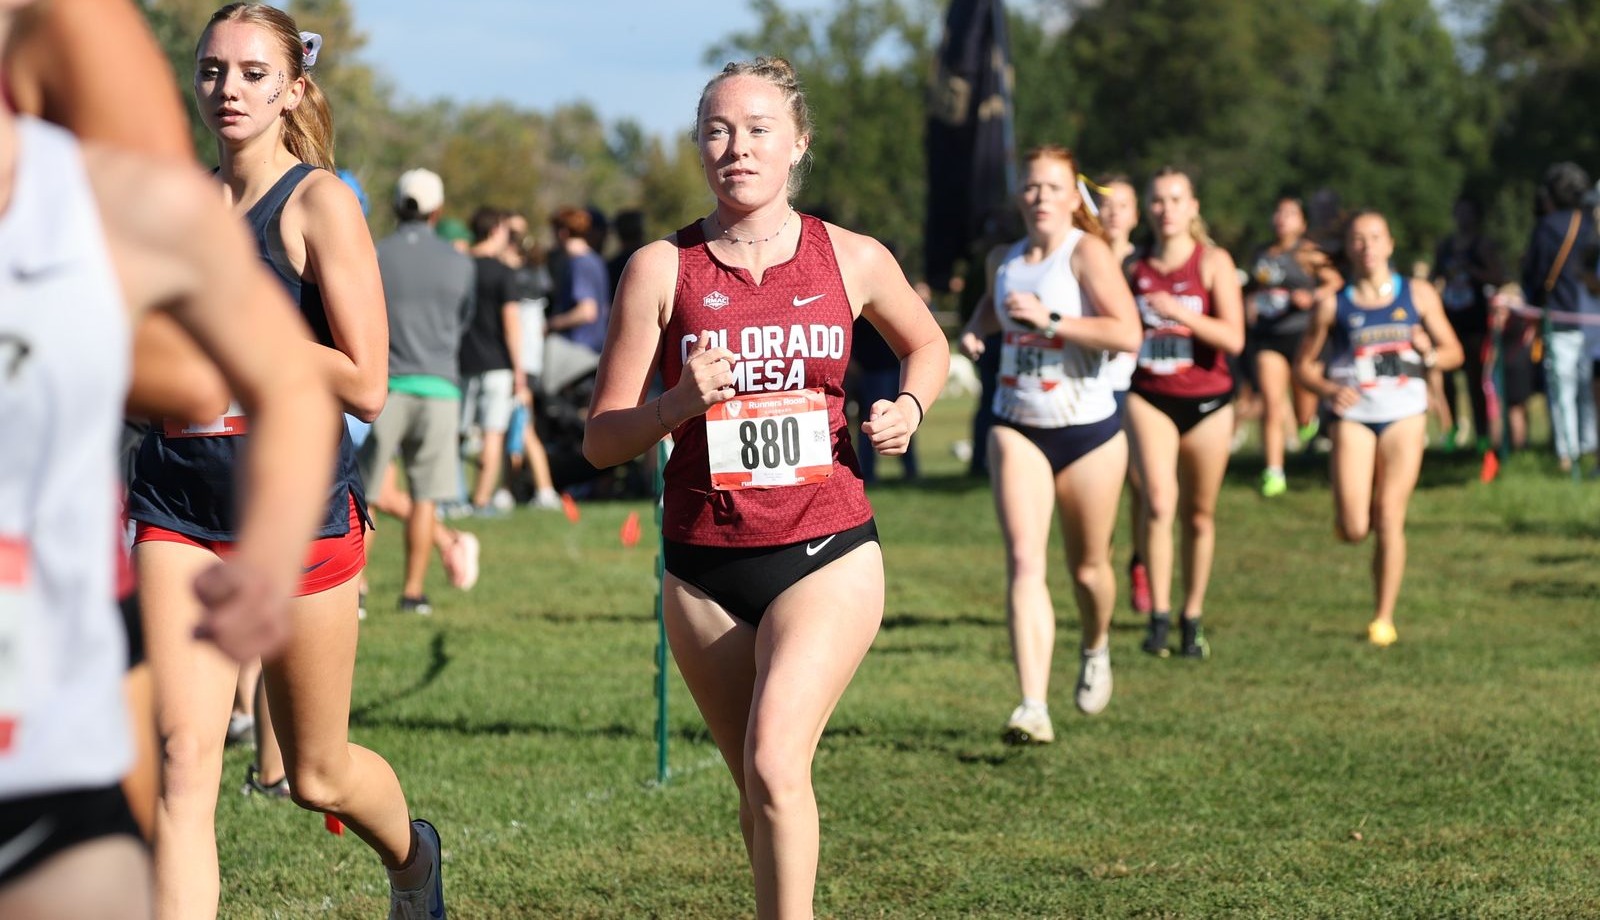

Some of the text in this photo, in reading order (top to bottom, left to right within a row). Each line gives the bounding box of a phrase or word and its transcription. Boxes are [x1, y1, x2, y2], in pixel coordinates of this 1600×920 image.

[731, 359, 805, 391] MESA
[748, 401, 782, 409] Runners
[739, 416, 800, 470] 880
